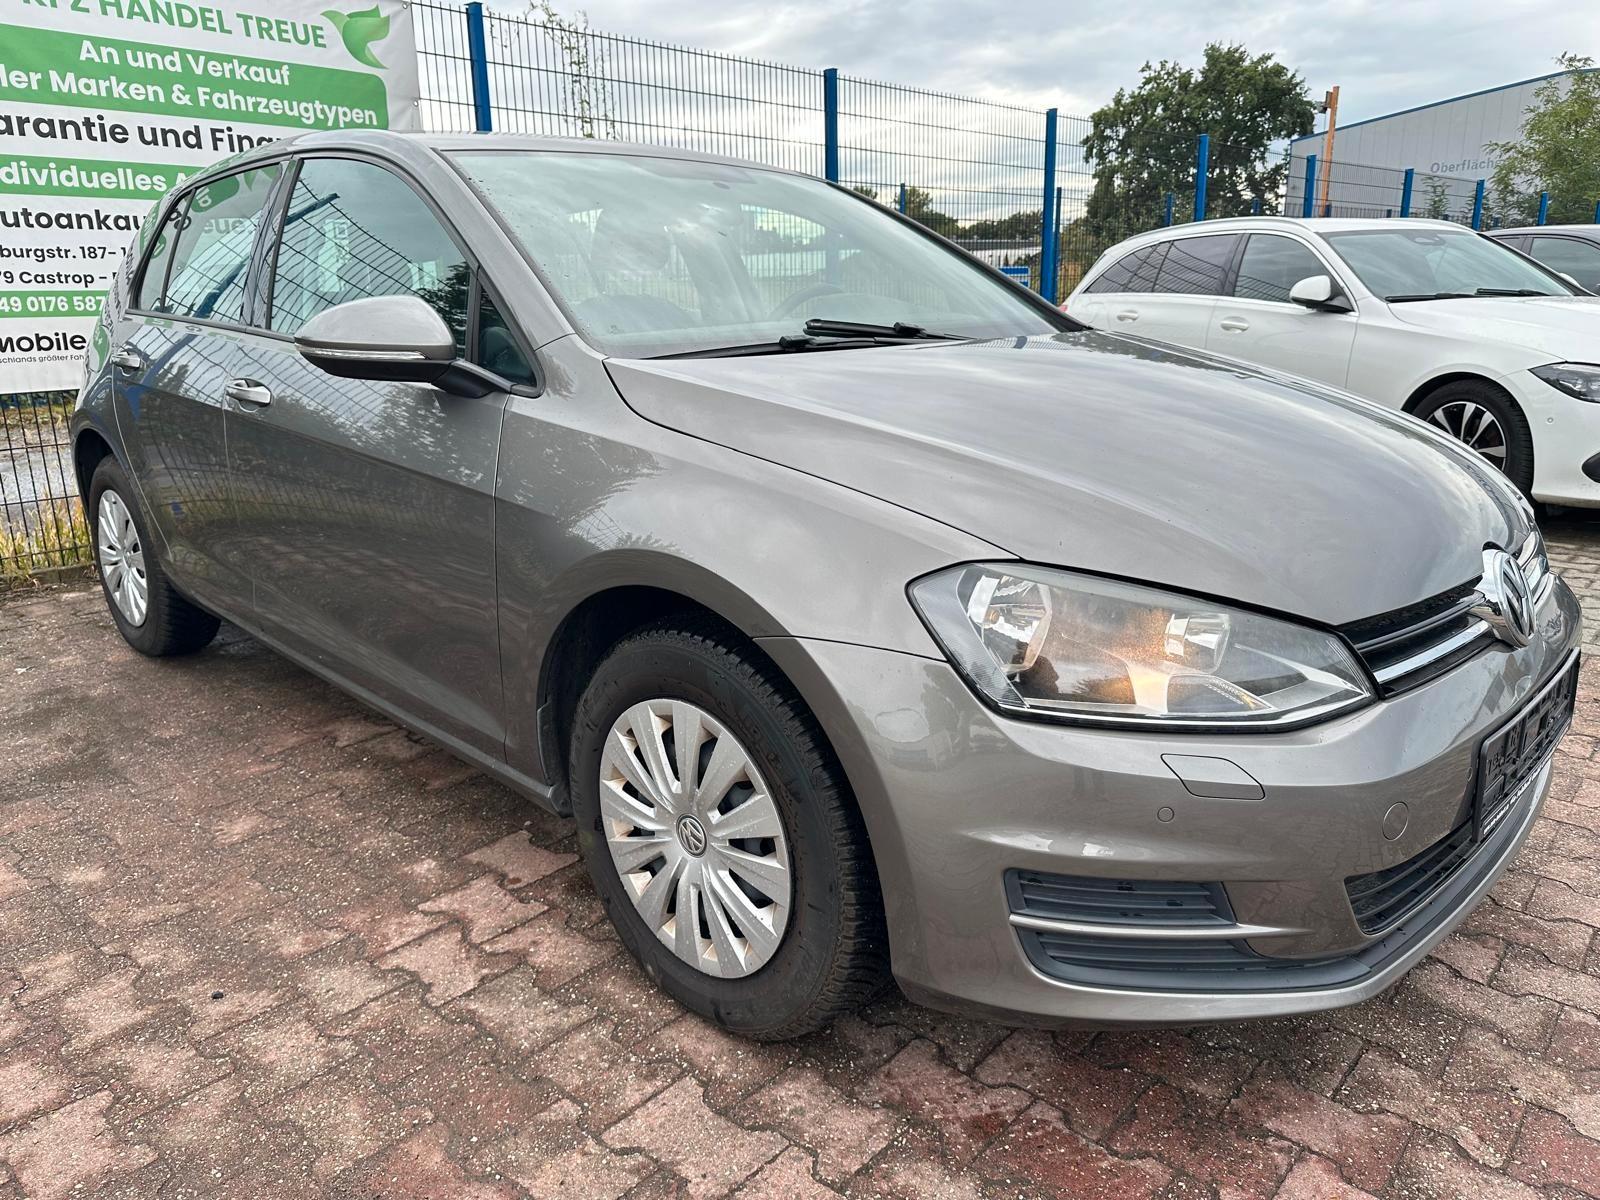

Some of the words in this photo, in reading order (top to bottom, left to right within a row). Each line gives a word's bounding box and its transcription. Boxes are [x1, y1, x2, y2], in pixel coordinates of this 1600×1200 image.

[97, 0, 232, 35] HANDEL
[236, 13, 327, 49] TREUE
[80, 39, 120, 65] An
[127, 47, 182, 74] und
[187, 55, 290, 86] Verkauf
[50, 69, 165, 103] Marken
[171, 84, 193, 106] &
[198, 87, 378, 129] Fahrzeugtypen
[138, 121, 202, 150] und
[0, 161, 167, 192] dividuelles
[0, 244, 76, 262] burgstr.
[19, 271, 95, 288] Castrop
[26, 296, 68, 311] 0176
